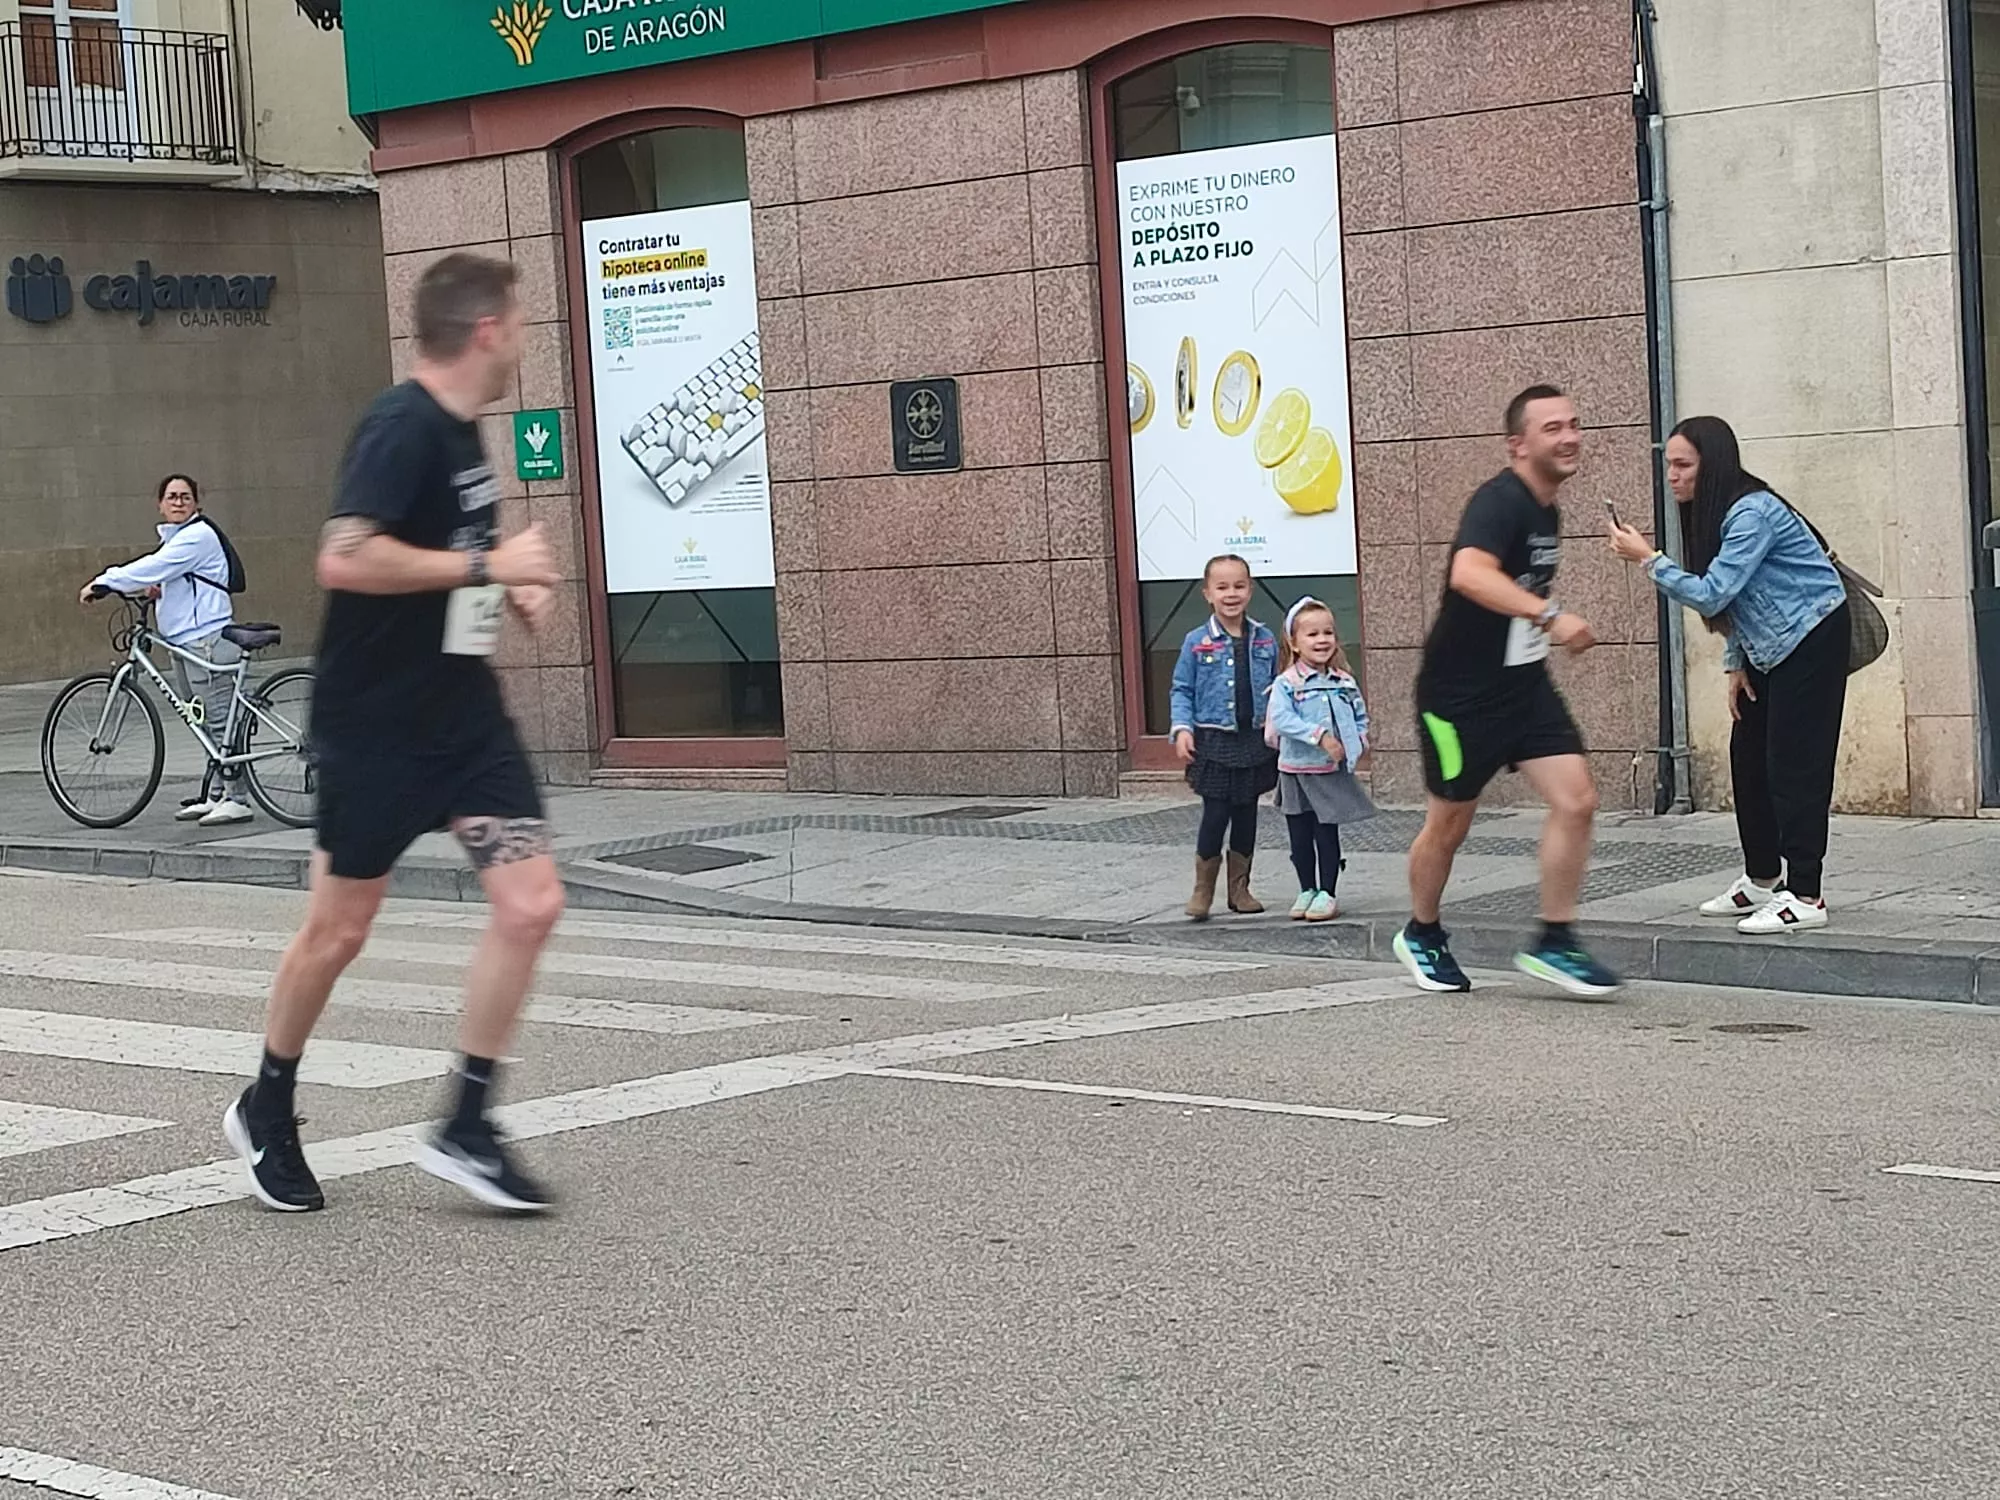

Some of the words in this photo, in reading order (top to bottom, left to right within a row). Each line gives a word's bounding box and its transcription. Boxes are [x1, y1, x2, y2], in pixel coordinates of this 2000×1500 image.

[585, 26, 616, 54] DE
[622, 4, 726, 48] ARAGÓN
[1129, 178, 1199, 201] EXPRIME
[1203, 175, 1226, 192] TU
[1230, 166, 1295, 190] DINERO
[1130, 205, 1165, 223] CON
[1171, 194, 1249, 219] NUESTRO
[599, 235, 663, 255] Contratar
[666, 233, 680, 247] tu
[1131, 221, 1220, 246] DEPÓSITO
[602, 259, 661, 279] hipoteca
[663, 251, 705, 270] online
[1133, 251, 1146, 268] A
[1150, 245, 1209, 266] PLAZO
[1214, 240, 1254, 259] FIJO
[84, 260, 277, 326] cajamar
[602, 283, 636, 300] tiene
[638, 278, 666, 296] más
[668, 272, 725, 292] ventajas
[1132, 280, 1162, 291] ENTRA
[1163, 279, 1169, 288] Y
[1171, 274, 1219, 287] CONSULTA
[1132, 291, 1196, 305] CONDICIONES
[180, 311, 221, 327] CAJA
[223, 311, 272, 327] RURAL
